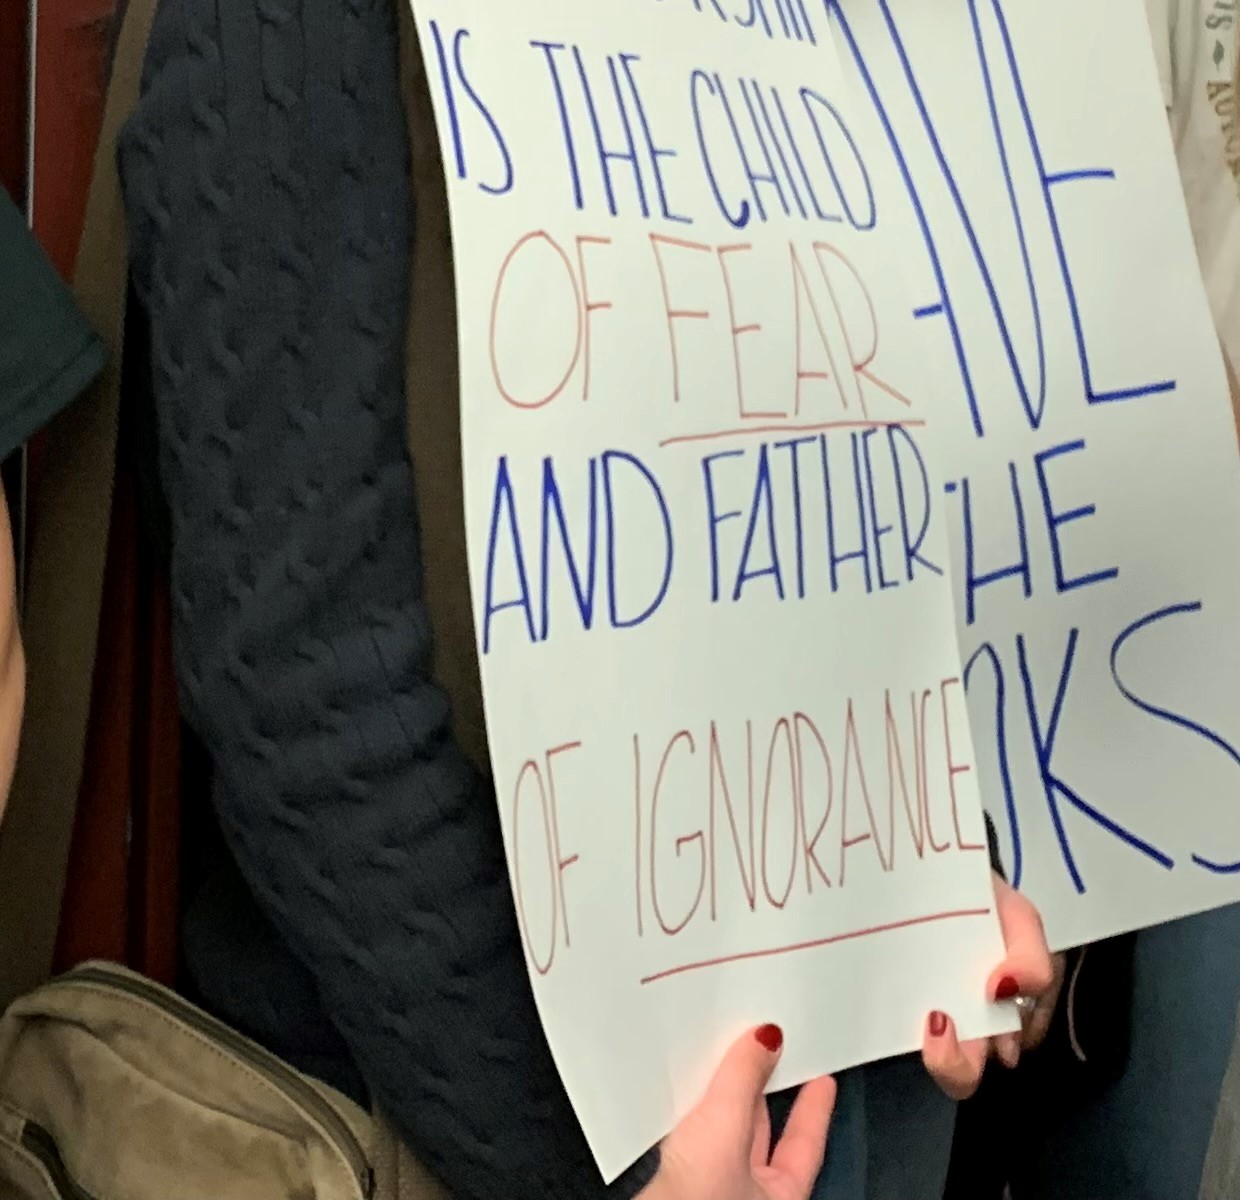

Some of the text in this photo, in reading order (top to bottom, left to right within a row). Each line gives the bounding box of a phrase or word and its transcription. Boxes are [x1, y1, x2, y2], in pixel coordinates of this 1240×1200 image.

[429, 19, 877, 230] IS THE CHILD
[490, 230, 913, 420] OF FEAR
[482, 422, 944, 654] AND FATHER
[944, 438, 1120, 625] HE
[513, 676, 986, 975] OF IGNORANCE
